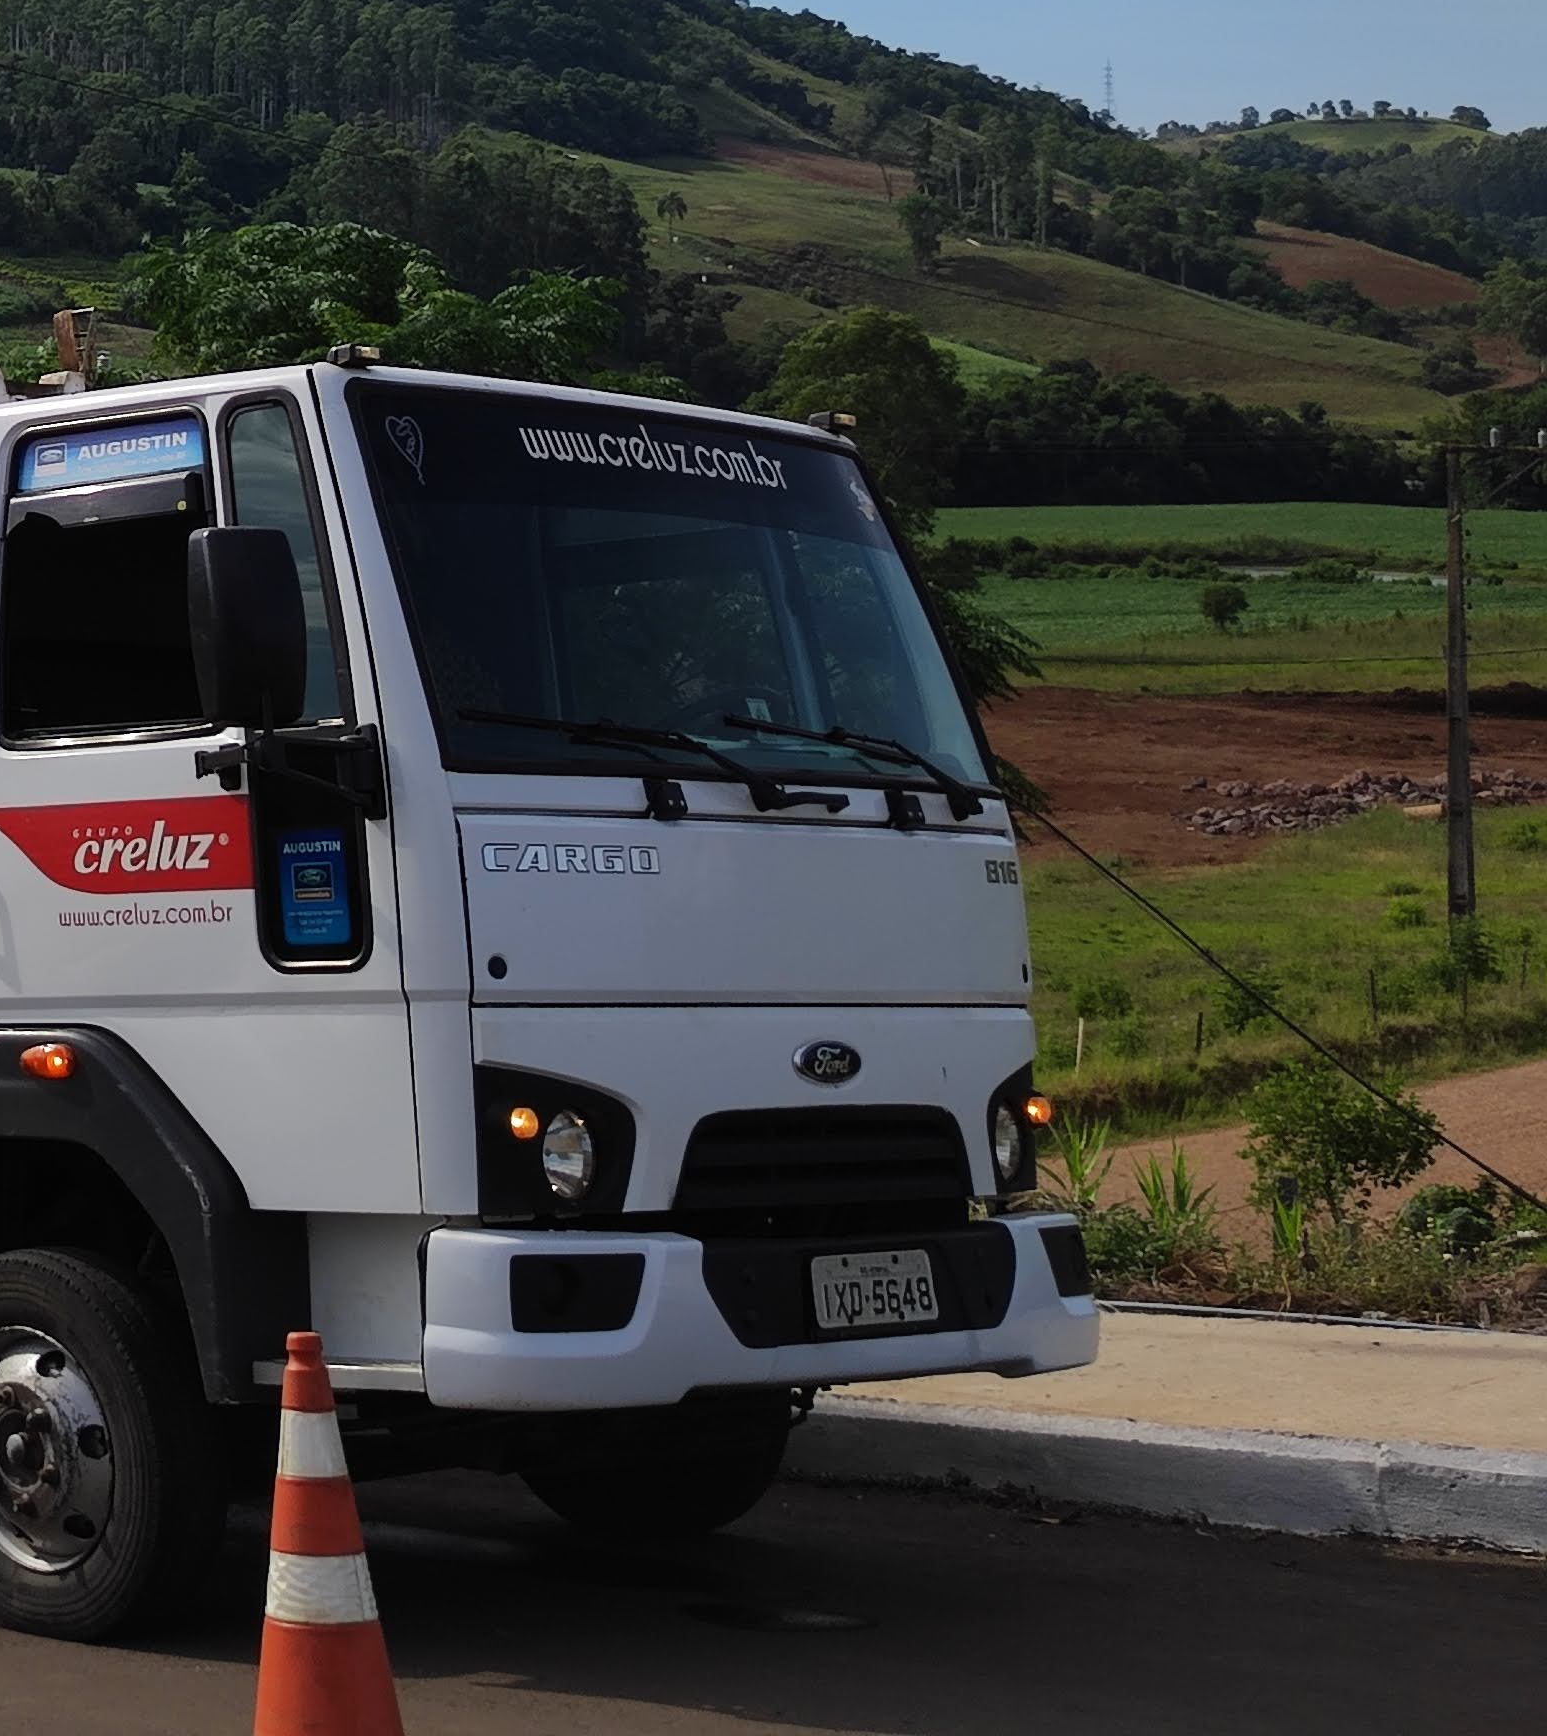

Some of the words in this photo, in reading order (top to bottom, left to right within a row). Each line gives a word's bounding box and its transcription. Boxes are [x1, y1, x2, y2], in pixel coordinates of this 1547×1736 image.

[77, 431, 188, 461] AUGUSTIN
[519, 424, 787, 489] www.creluz.com.br
[72, 825, 133, 839] GRUPO
[74, 820, 214, 874] creluz
[283, 840, 341, 854] AUGUSTIN
[482, 843, 661, 874] CARGO
[985, 860, 1018, 884] 816
[59, 899, 233, 927] www.creluz.com.br
[814, 1046, 850, 1074] Ford
